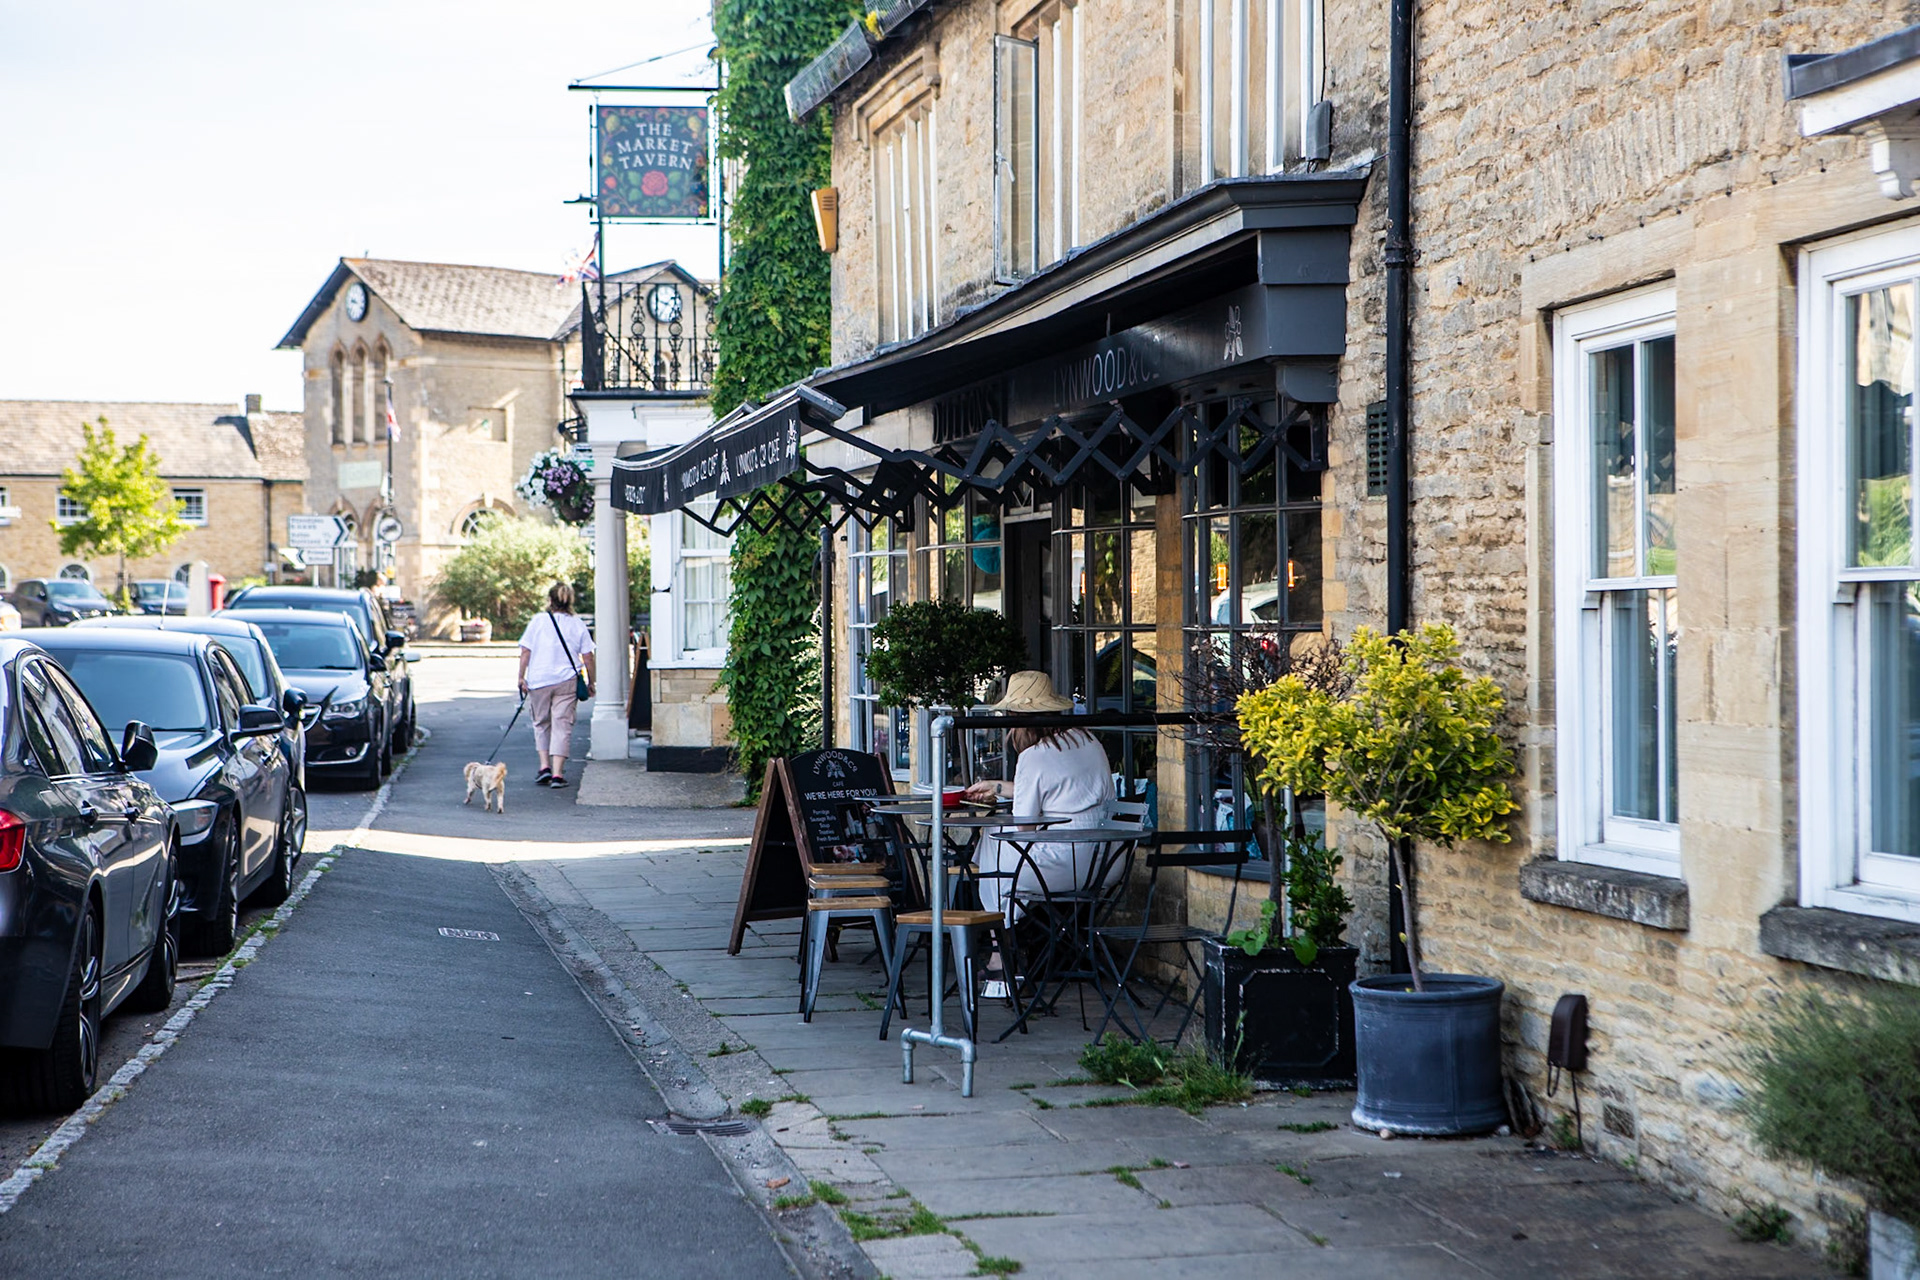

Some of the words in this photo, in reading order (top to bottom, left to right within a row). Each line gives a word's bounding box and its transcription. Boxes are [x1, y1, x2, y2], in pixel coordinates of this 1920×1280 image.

[635, 123, 672, 137] THE
[616, 137, 693, 154] MARKET
[618, 153, 693, 170] TAVERN
[804, 790, 827, 801] WE'RE
[827, 789, 845, 799] HERE
[845, 789, 860, 798] FOR
[860, 788, 878, 797] YOU!
